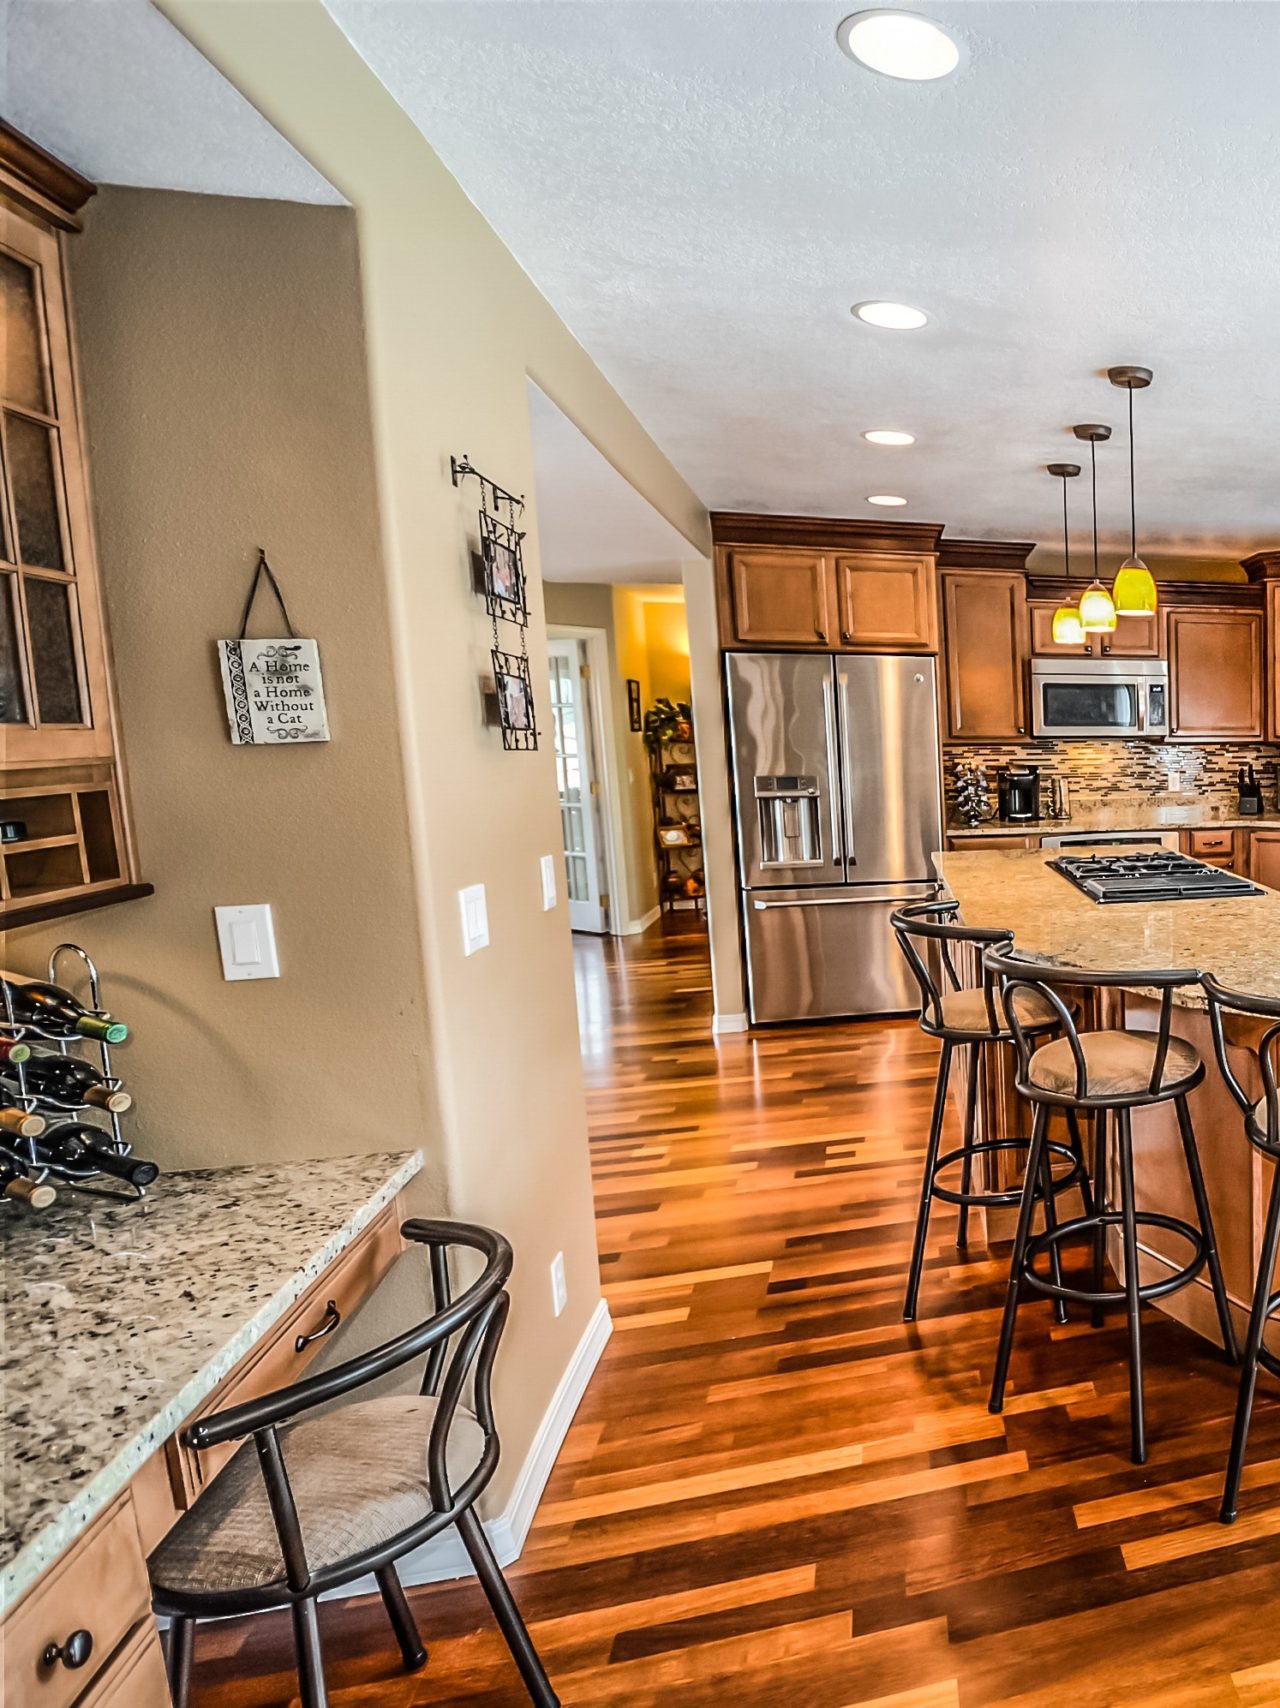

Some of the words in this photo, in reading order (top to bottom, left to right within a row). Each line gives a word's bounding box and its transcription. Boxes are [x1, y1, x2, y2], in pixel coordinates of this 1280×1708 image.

[249, 662, 259, 672] A
[265, 660, 310, 672] Home
[262, 673, 273, 684] is
[276, 674, 300, 684] not
[254, 689, 260, 698] a
[265, 686, 311, 698] Home
[254, 700, 314, 712] Without
[267, 716, 274, 724] a
[278, 713, 303, 724] Cat
